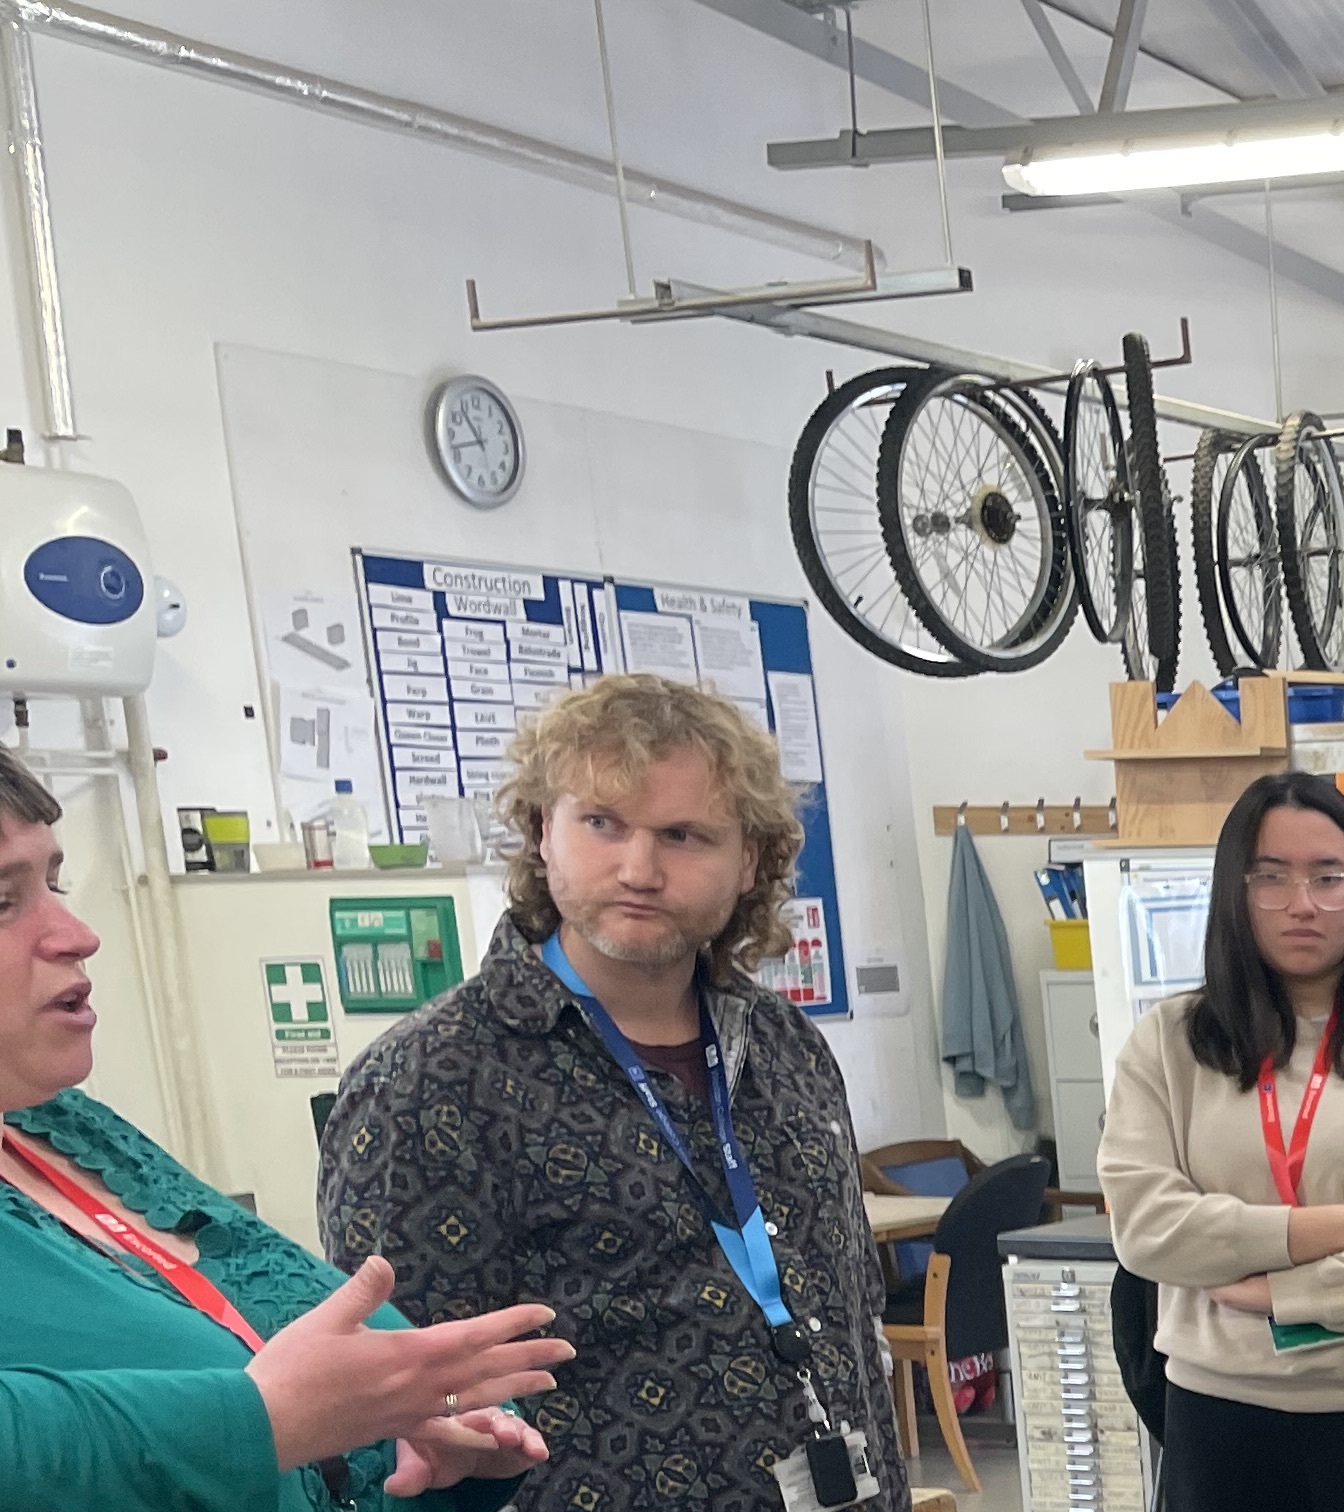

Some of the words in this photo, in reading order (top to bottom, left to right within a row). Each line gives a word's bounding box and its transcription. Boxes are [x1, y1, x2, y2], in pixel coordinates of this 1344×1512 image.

[432, 567, 532, 596] Construction
[453, 595, 518, 617] Wordwall
[660, 593, 698, 613] Health
[699, 600, 708, 613] &
[710, 598, 743, 620] Safety
